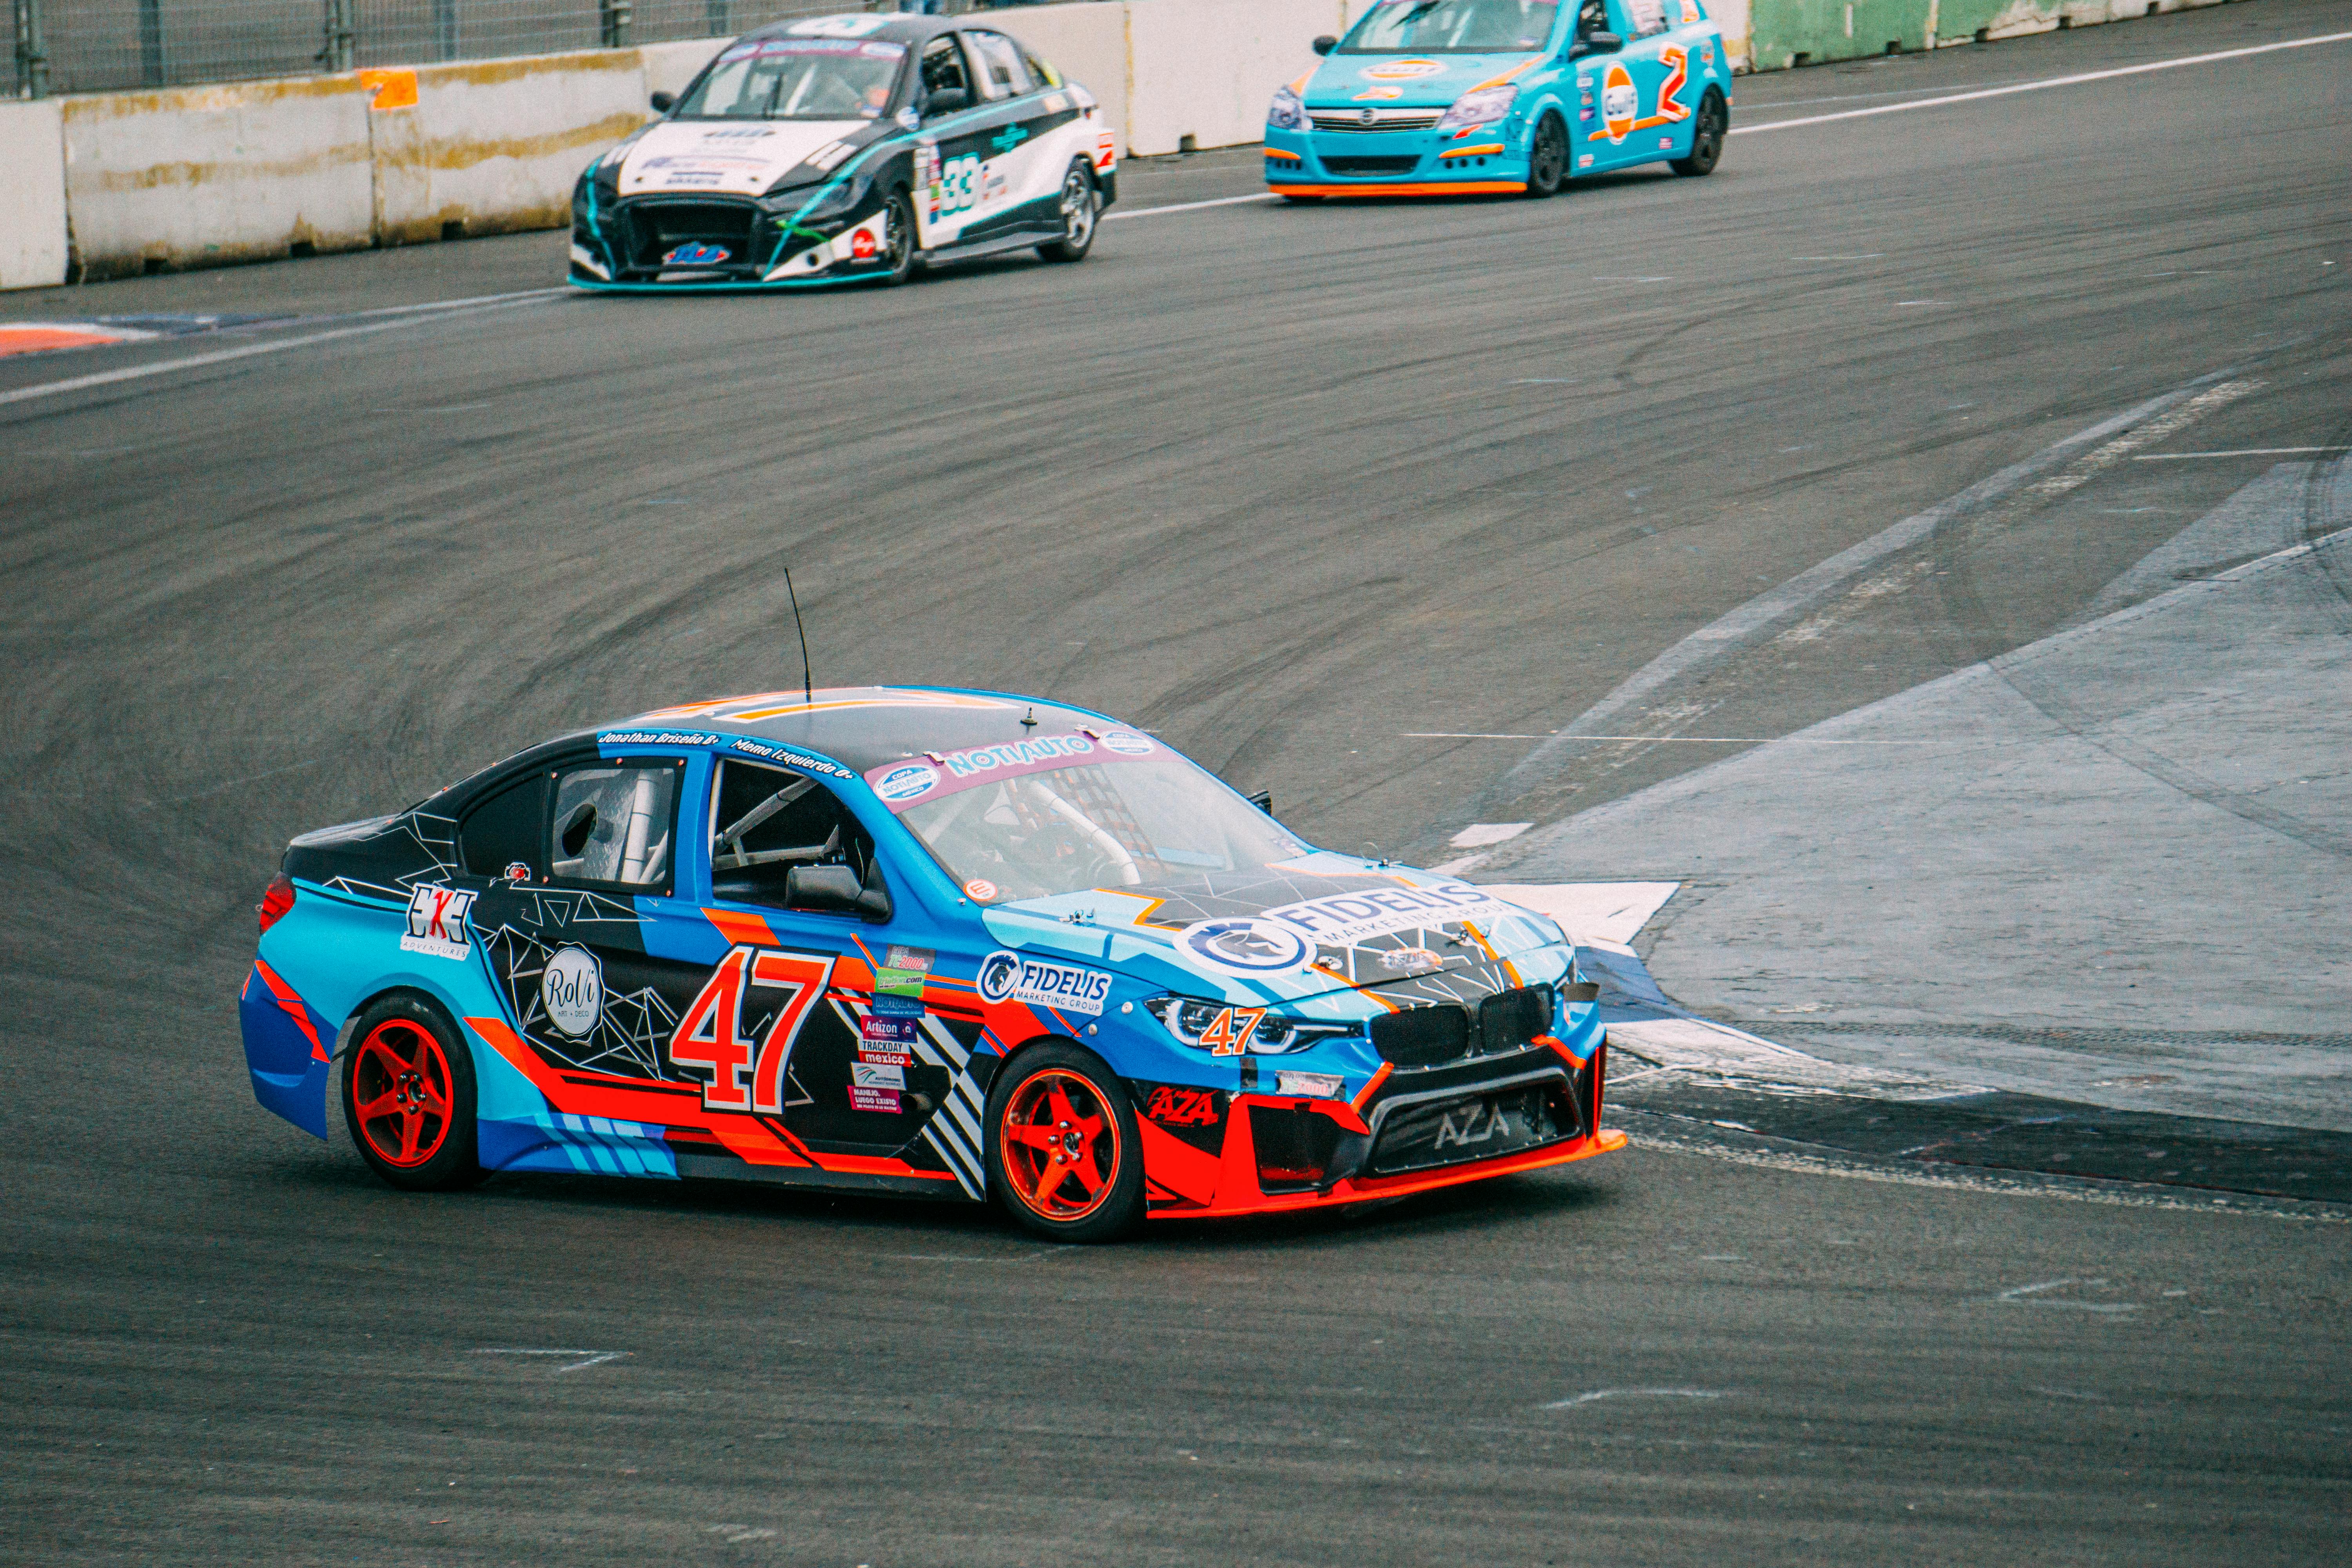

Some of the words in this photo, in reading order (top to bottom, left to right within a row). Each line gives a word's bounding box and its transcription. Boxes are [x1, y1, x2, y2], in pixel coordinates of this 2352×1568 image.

[1657, 41, 1691, 122] 2
[941, 151, 980, 217] 33
[598, 732, 657, 743] Jonathan
[655, 733, 704, 744] Briseño
[702, 735, 720, 745] B+
[730, 739, 773, 756] Memo
[771, 749, 836, 773] Izquierdo
[945, 735, 1094, 778] NOTIAUTO
[882, 773, 931, 793] NOTIAUTO
[892, 769, 913, 780] COPA
[1274, 885, 1490, 932] FIDELIS
[1326, 911, 1443, 942] MARKETING
[403, 942, 466, 957] ADVENTURES
[1020, 964, 1109, 1000] FIDELIS
[1016, 991, 1066, 1005] MARKETING
[1070, 1001, 1100, 1012] GROUP
[669, 945, 836, 1114] 47
[866, 1020, 897, 1034] Artizon
[1199, 1007, 1267, 1056] 47
[862, 1041, 902, 1052] TRACKDAY
[865, 1053, 906, 1064] mexico
[1434, 1102, 1510, 1150] AZA
